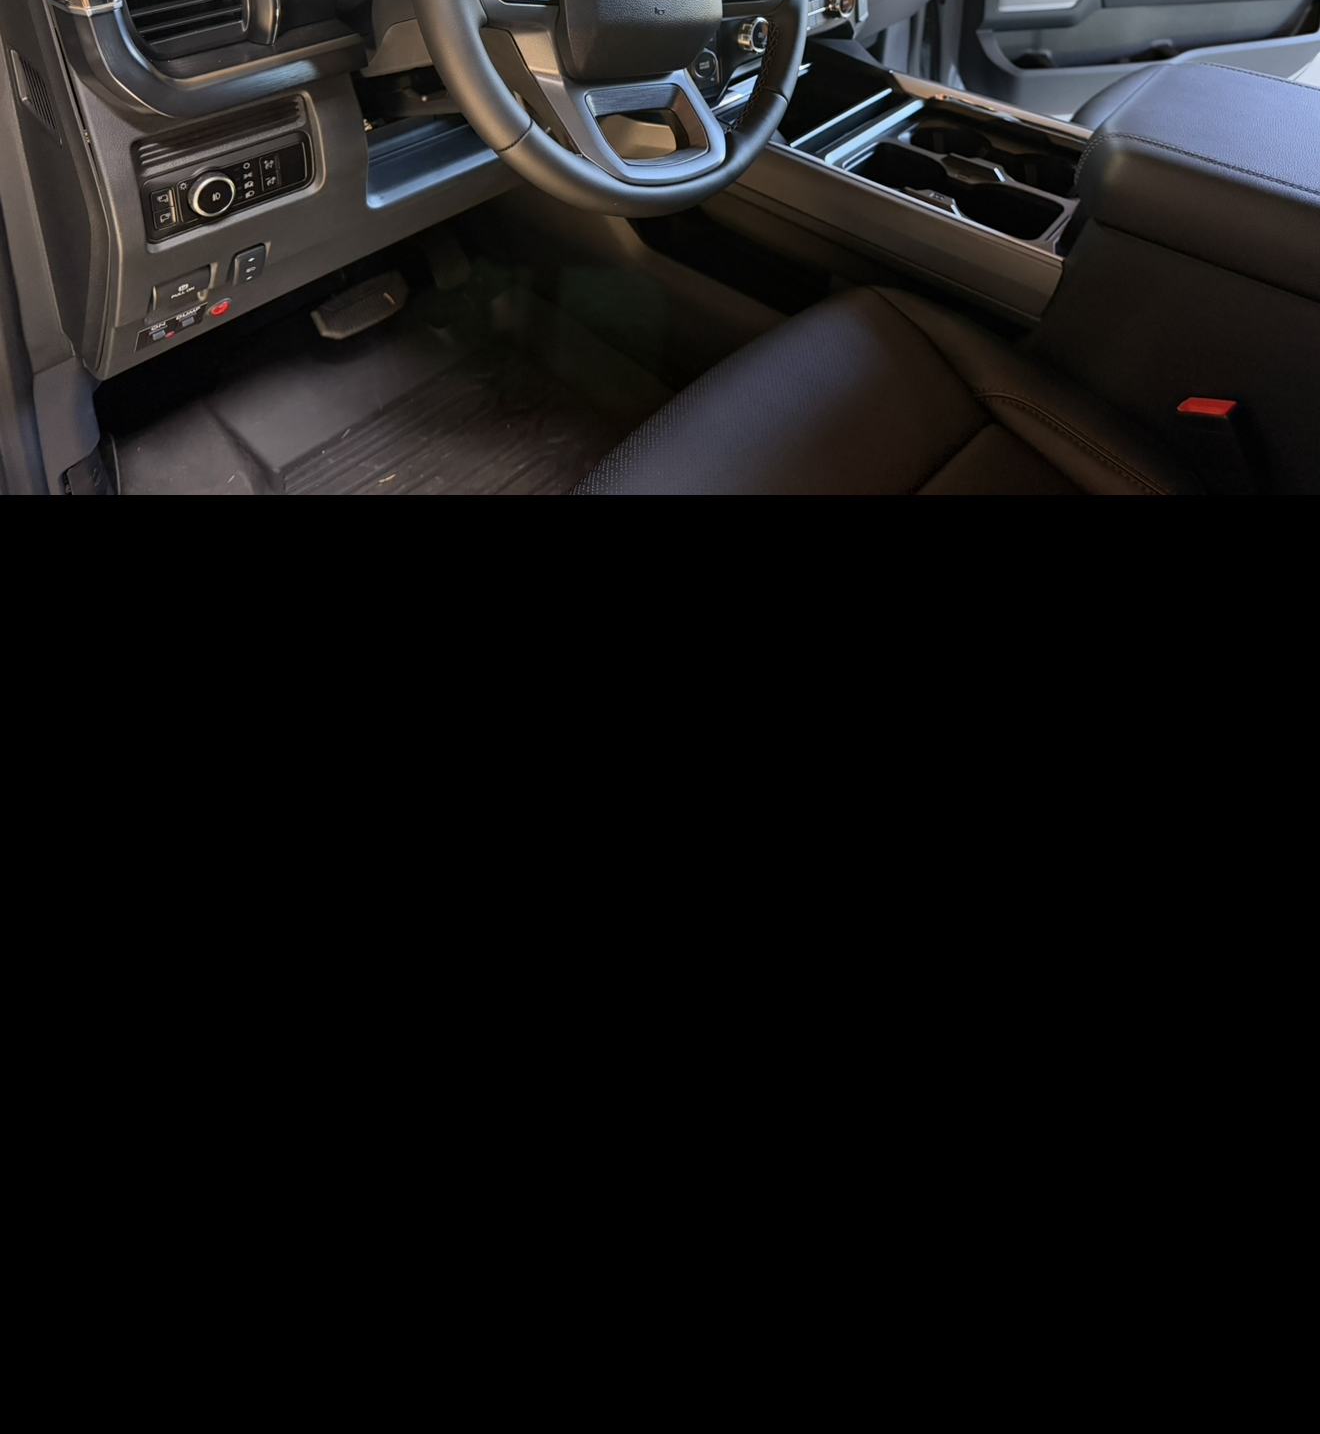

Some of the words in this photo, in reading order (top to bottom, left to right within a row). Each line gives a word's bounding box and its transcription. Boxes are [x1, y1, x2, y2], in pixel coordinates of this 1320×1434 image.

[171, 291, 185, 299] PULL
[176, 306, 201, 320] DUMP
[151, 322, 166, 331] ON
